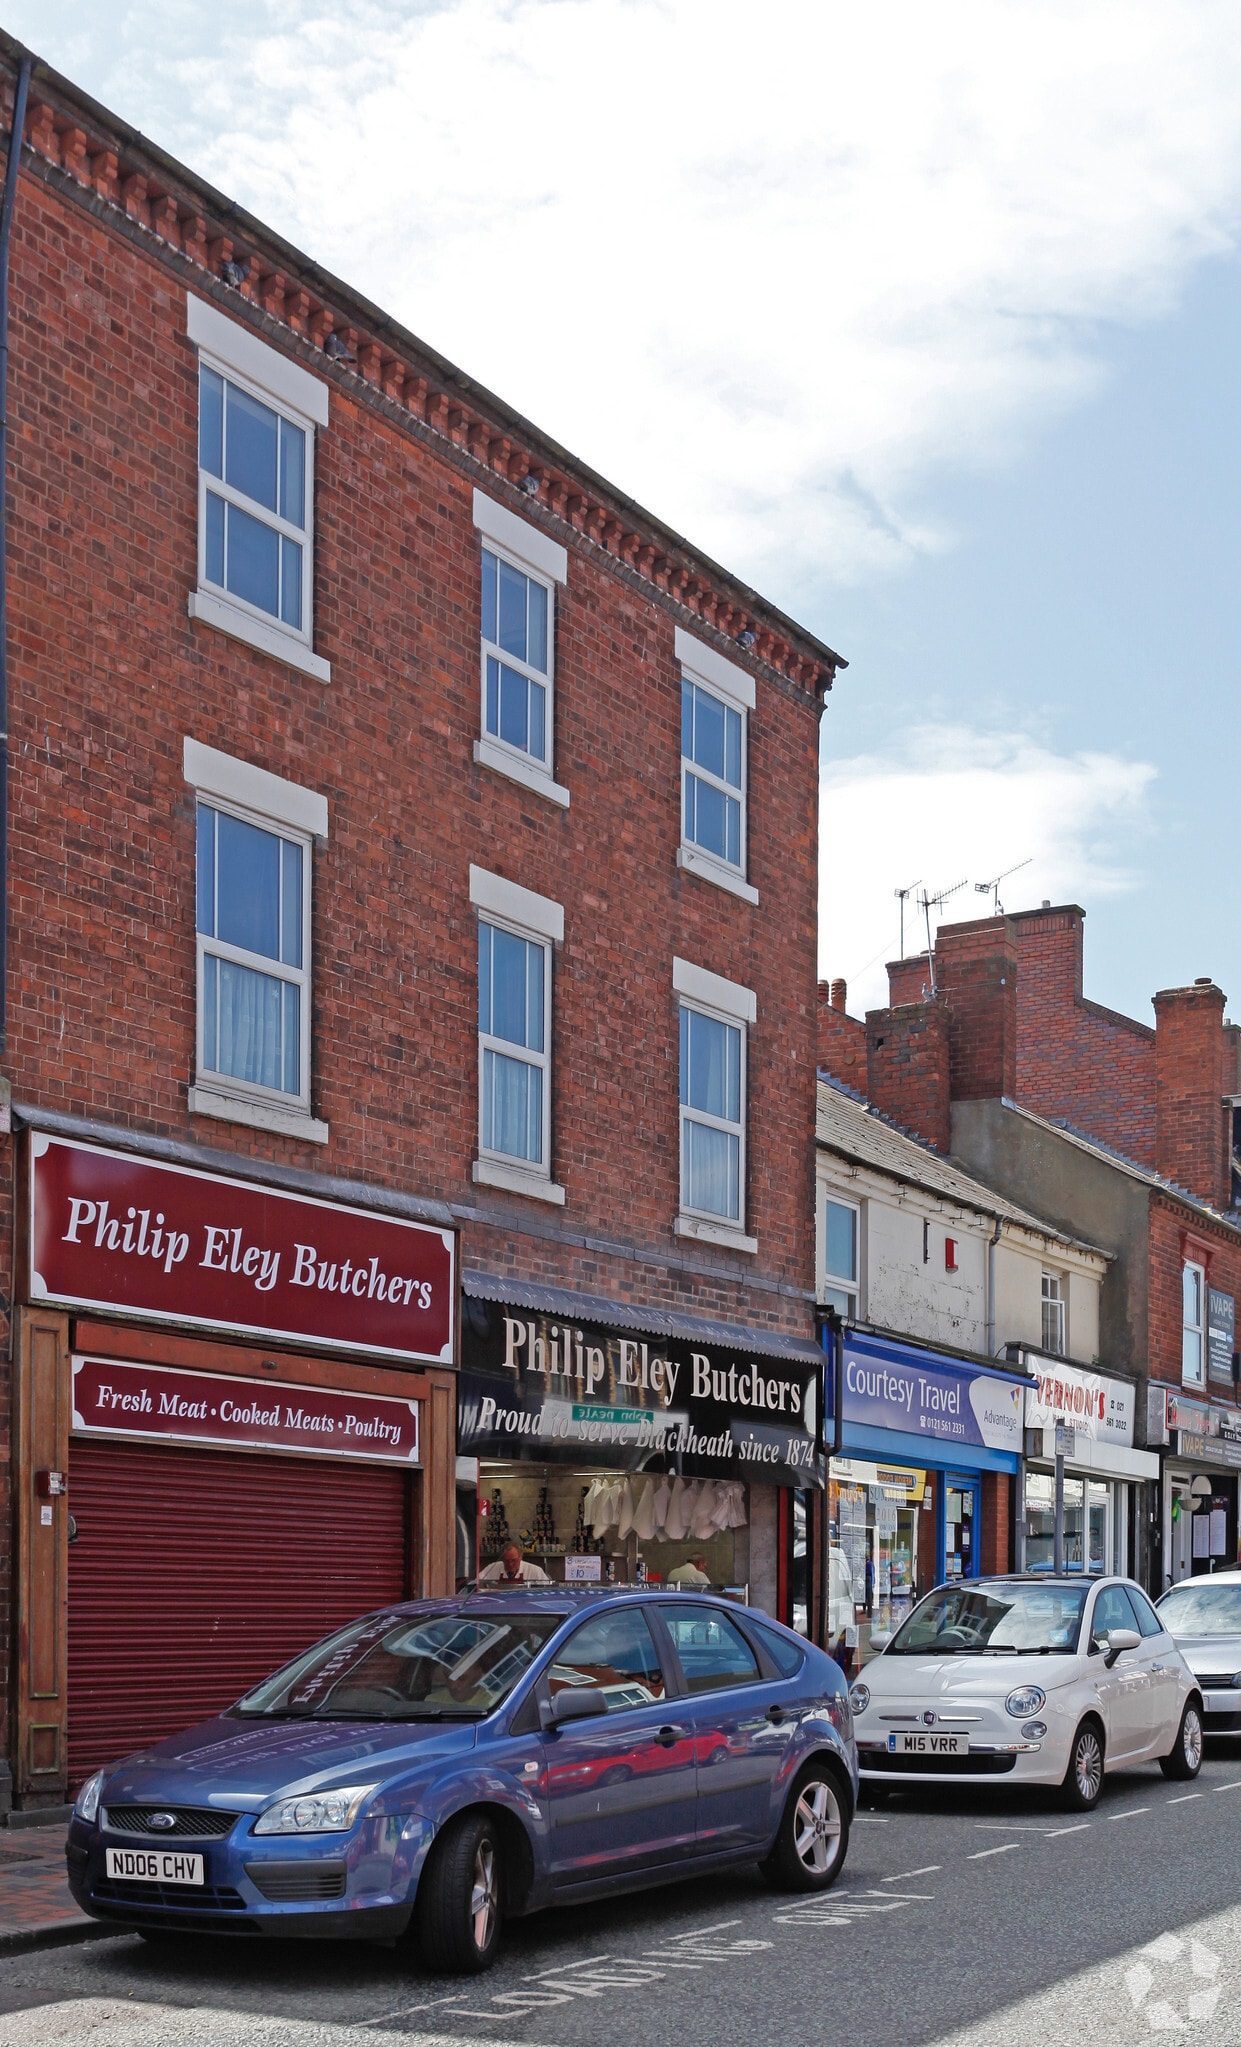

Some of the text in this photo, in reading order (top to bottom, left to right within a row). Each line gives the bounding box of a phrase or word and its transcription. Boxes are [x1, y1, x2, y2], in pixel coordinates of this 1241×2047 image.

[61, 1197, 433, 1309] Philip Eley Butchers
[502, 1317, 801, 1414] Philip Eley Butchers
[846, 1361, 961, 1415] Courtesy Travel
[1036, 1374, 1105, 1420] VERNON'S
[96, 1384, 402, 1445] Fresh Meat Cooked Meats Poultry
[477, 1397, 544, 1436] Proud
[551, 1409, 569, 1440] to
[577, 1419, 628, 1446] serve
[635, 1418, 734, 1460] Blackheath
[738, 1434, 780, 1464] since
[785, 1438, 815, 1468] 1874
[927, 1417, 965, 1434] 0121 561 2331
[983, 1410, 1018, 1431] Advantage
[1106, 1417, 1127, 1430] 561 3022
[931, 1737, 958, 1752] VRR
[150, 1816, 167, 1826] Ford
[113, 1852, 195, 1880] ND06 CHV
[771, 1889, 935, 1925] ONLY
[442, 1935, 776, 2020] LOADING
